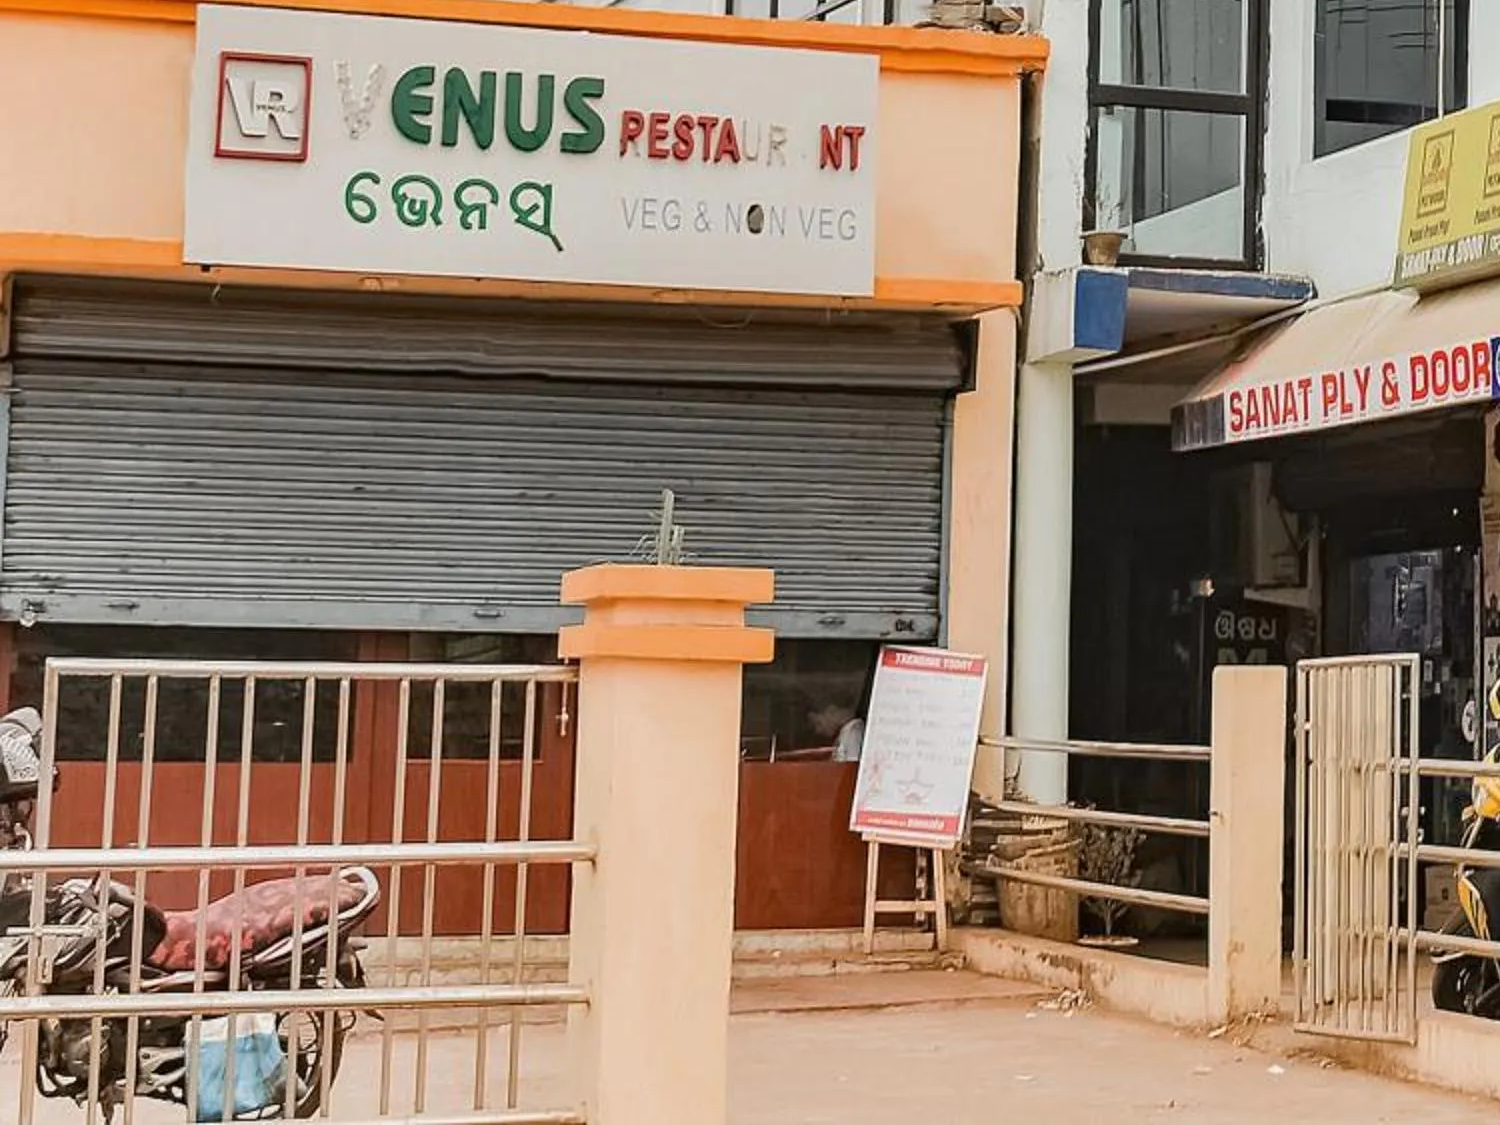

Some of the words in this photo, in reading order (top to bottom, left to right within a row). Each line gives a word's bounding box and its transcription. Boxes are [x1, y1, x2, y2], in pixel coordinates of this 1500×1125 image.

[618, 109, 866, 172] RESTAURNT
[620, 197, 682, 231] VEG
[693, 199, 712, 231] &
[725, 201, 786, 236] NON
[798, 205, 857, 241] VEG
[1229, 377, 1312, 432] SANAT
[1321, 366, 1371, 416] PLY
[1381, 362, 1400, 406] &
[1410, 341, 1492, 401] DOOR
